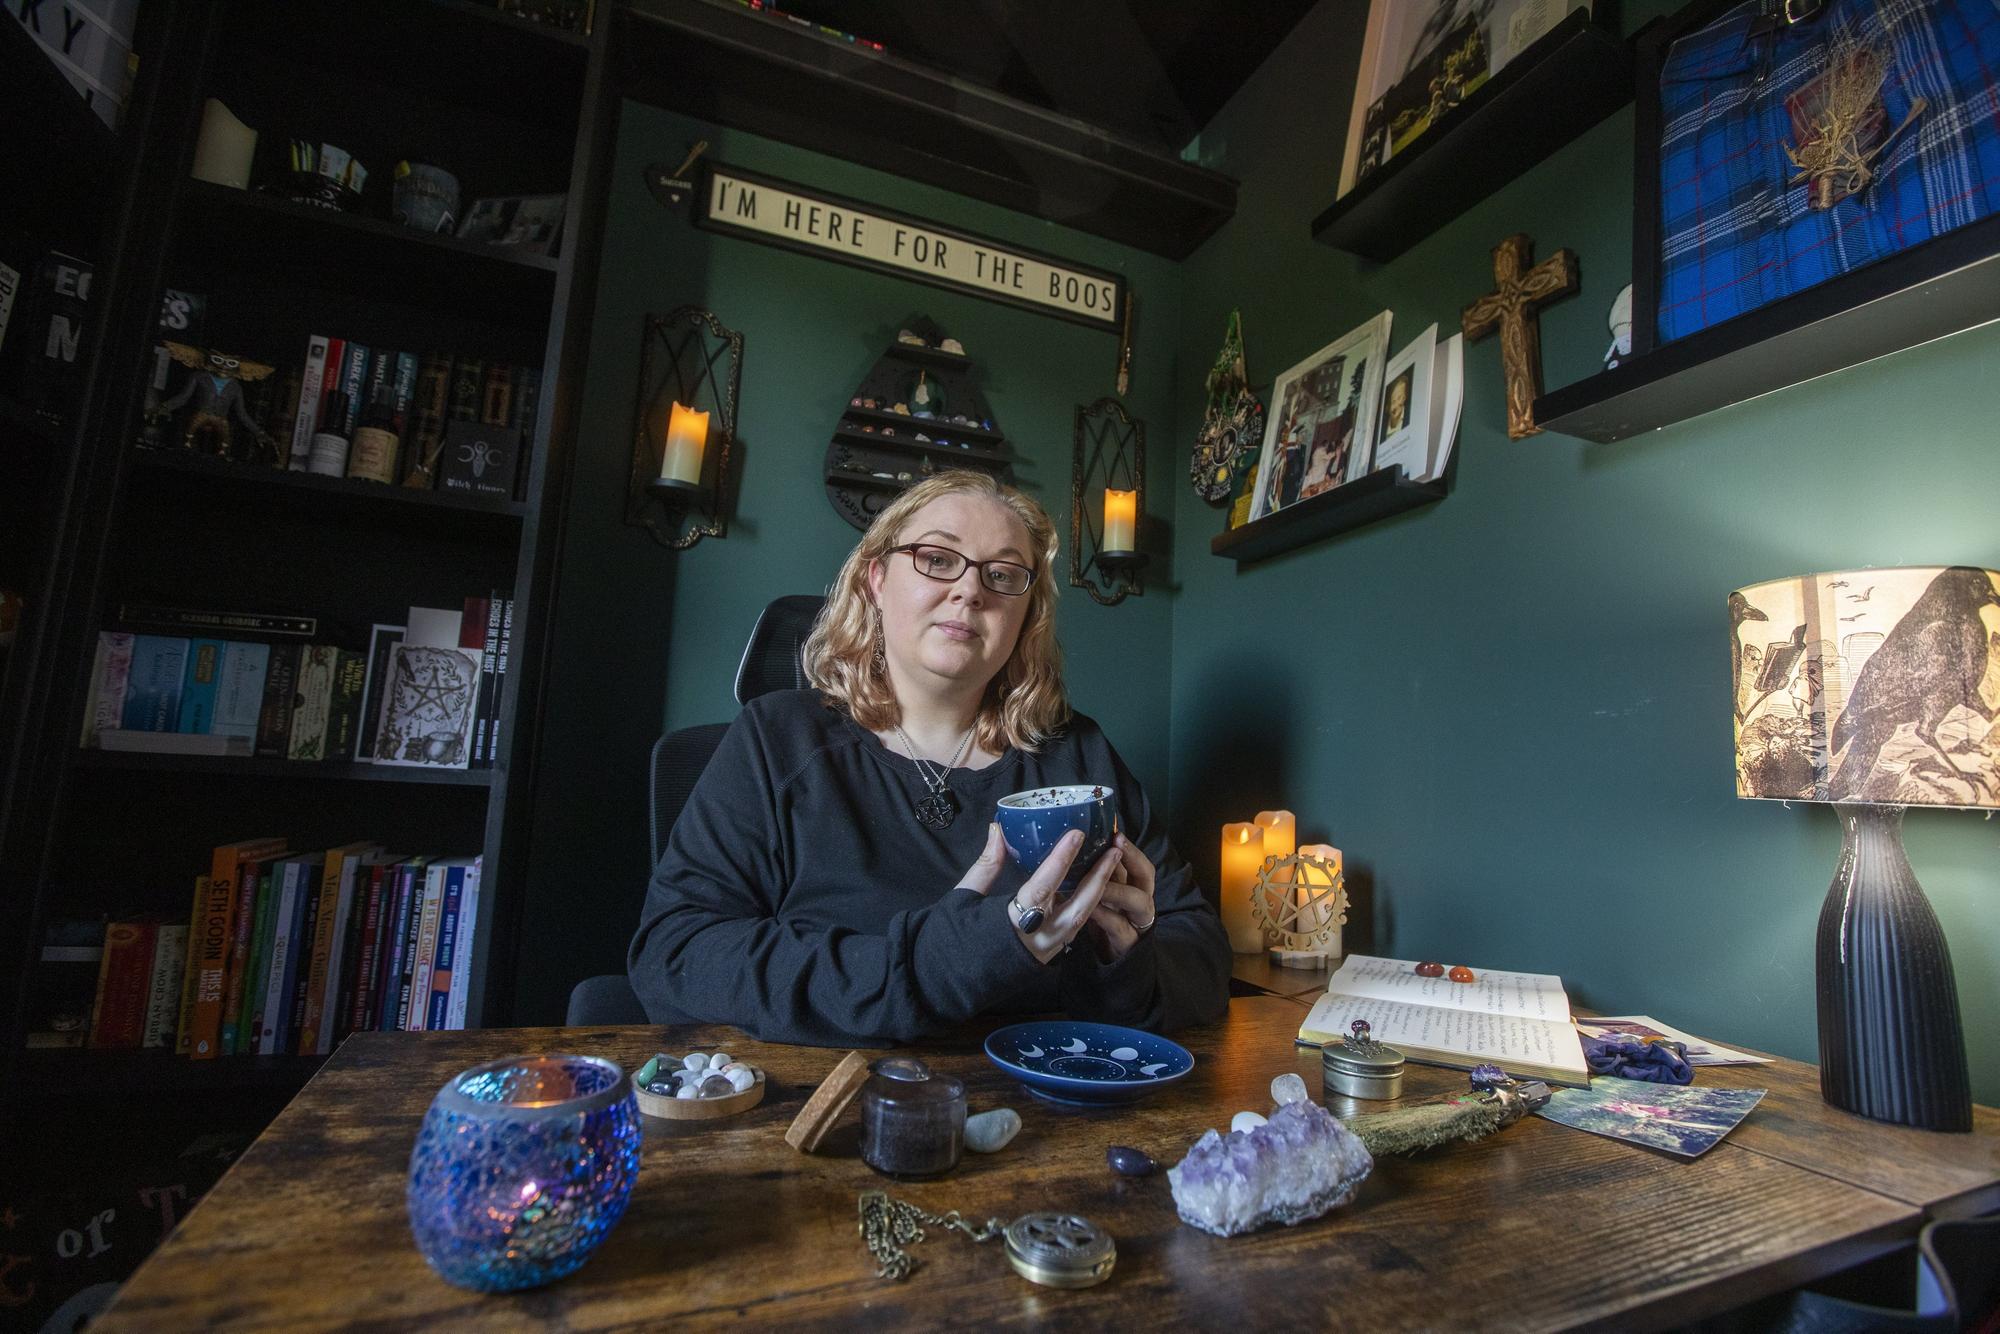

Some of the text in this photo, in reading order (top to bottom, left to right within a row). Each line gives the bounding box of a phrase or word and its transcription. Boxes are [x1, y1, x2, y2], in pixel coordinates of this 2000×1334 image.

[659, 175, 692, 190] Success
[718, 180, 1113, 313] I'M HERE FOR THE BOOS
[348, 348, 364, 381] DARK
[482, 598, 502, 675] ECHOES IN THE MIST
[324, 873, 340, 904] Make
[450, 884, 458, 896] IT'S
[204, 880, 230, 961] SETH GODIN
[315, 906, 333, 947] Money
[404, 889, 423, 975] GROWTH HACKER MARKETING
[445, 914, 454, 933] ABOUT
[271, 935, 286, 972] SQUARE
[419, 937, 432, 967] CHANCE
[441, 945, 450, 966] MONEY
[443, 933, 452, 945] THE
[206, 967, 224, 1003] THIS IS
[310, 950, 327, 993] Online
[149, 968, 167, 1043] URBAN CROW
[397, 984, 410, 1031] RYAN HOLIDAY
[435, 995, 444, 1021] Catherine
[56, 1207, 117, 1259] of
